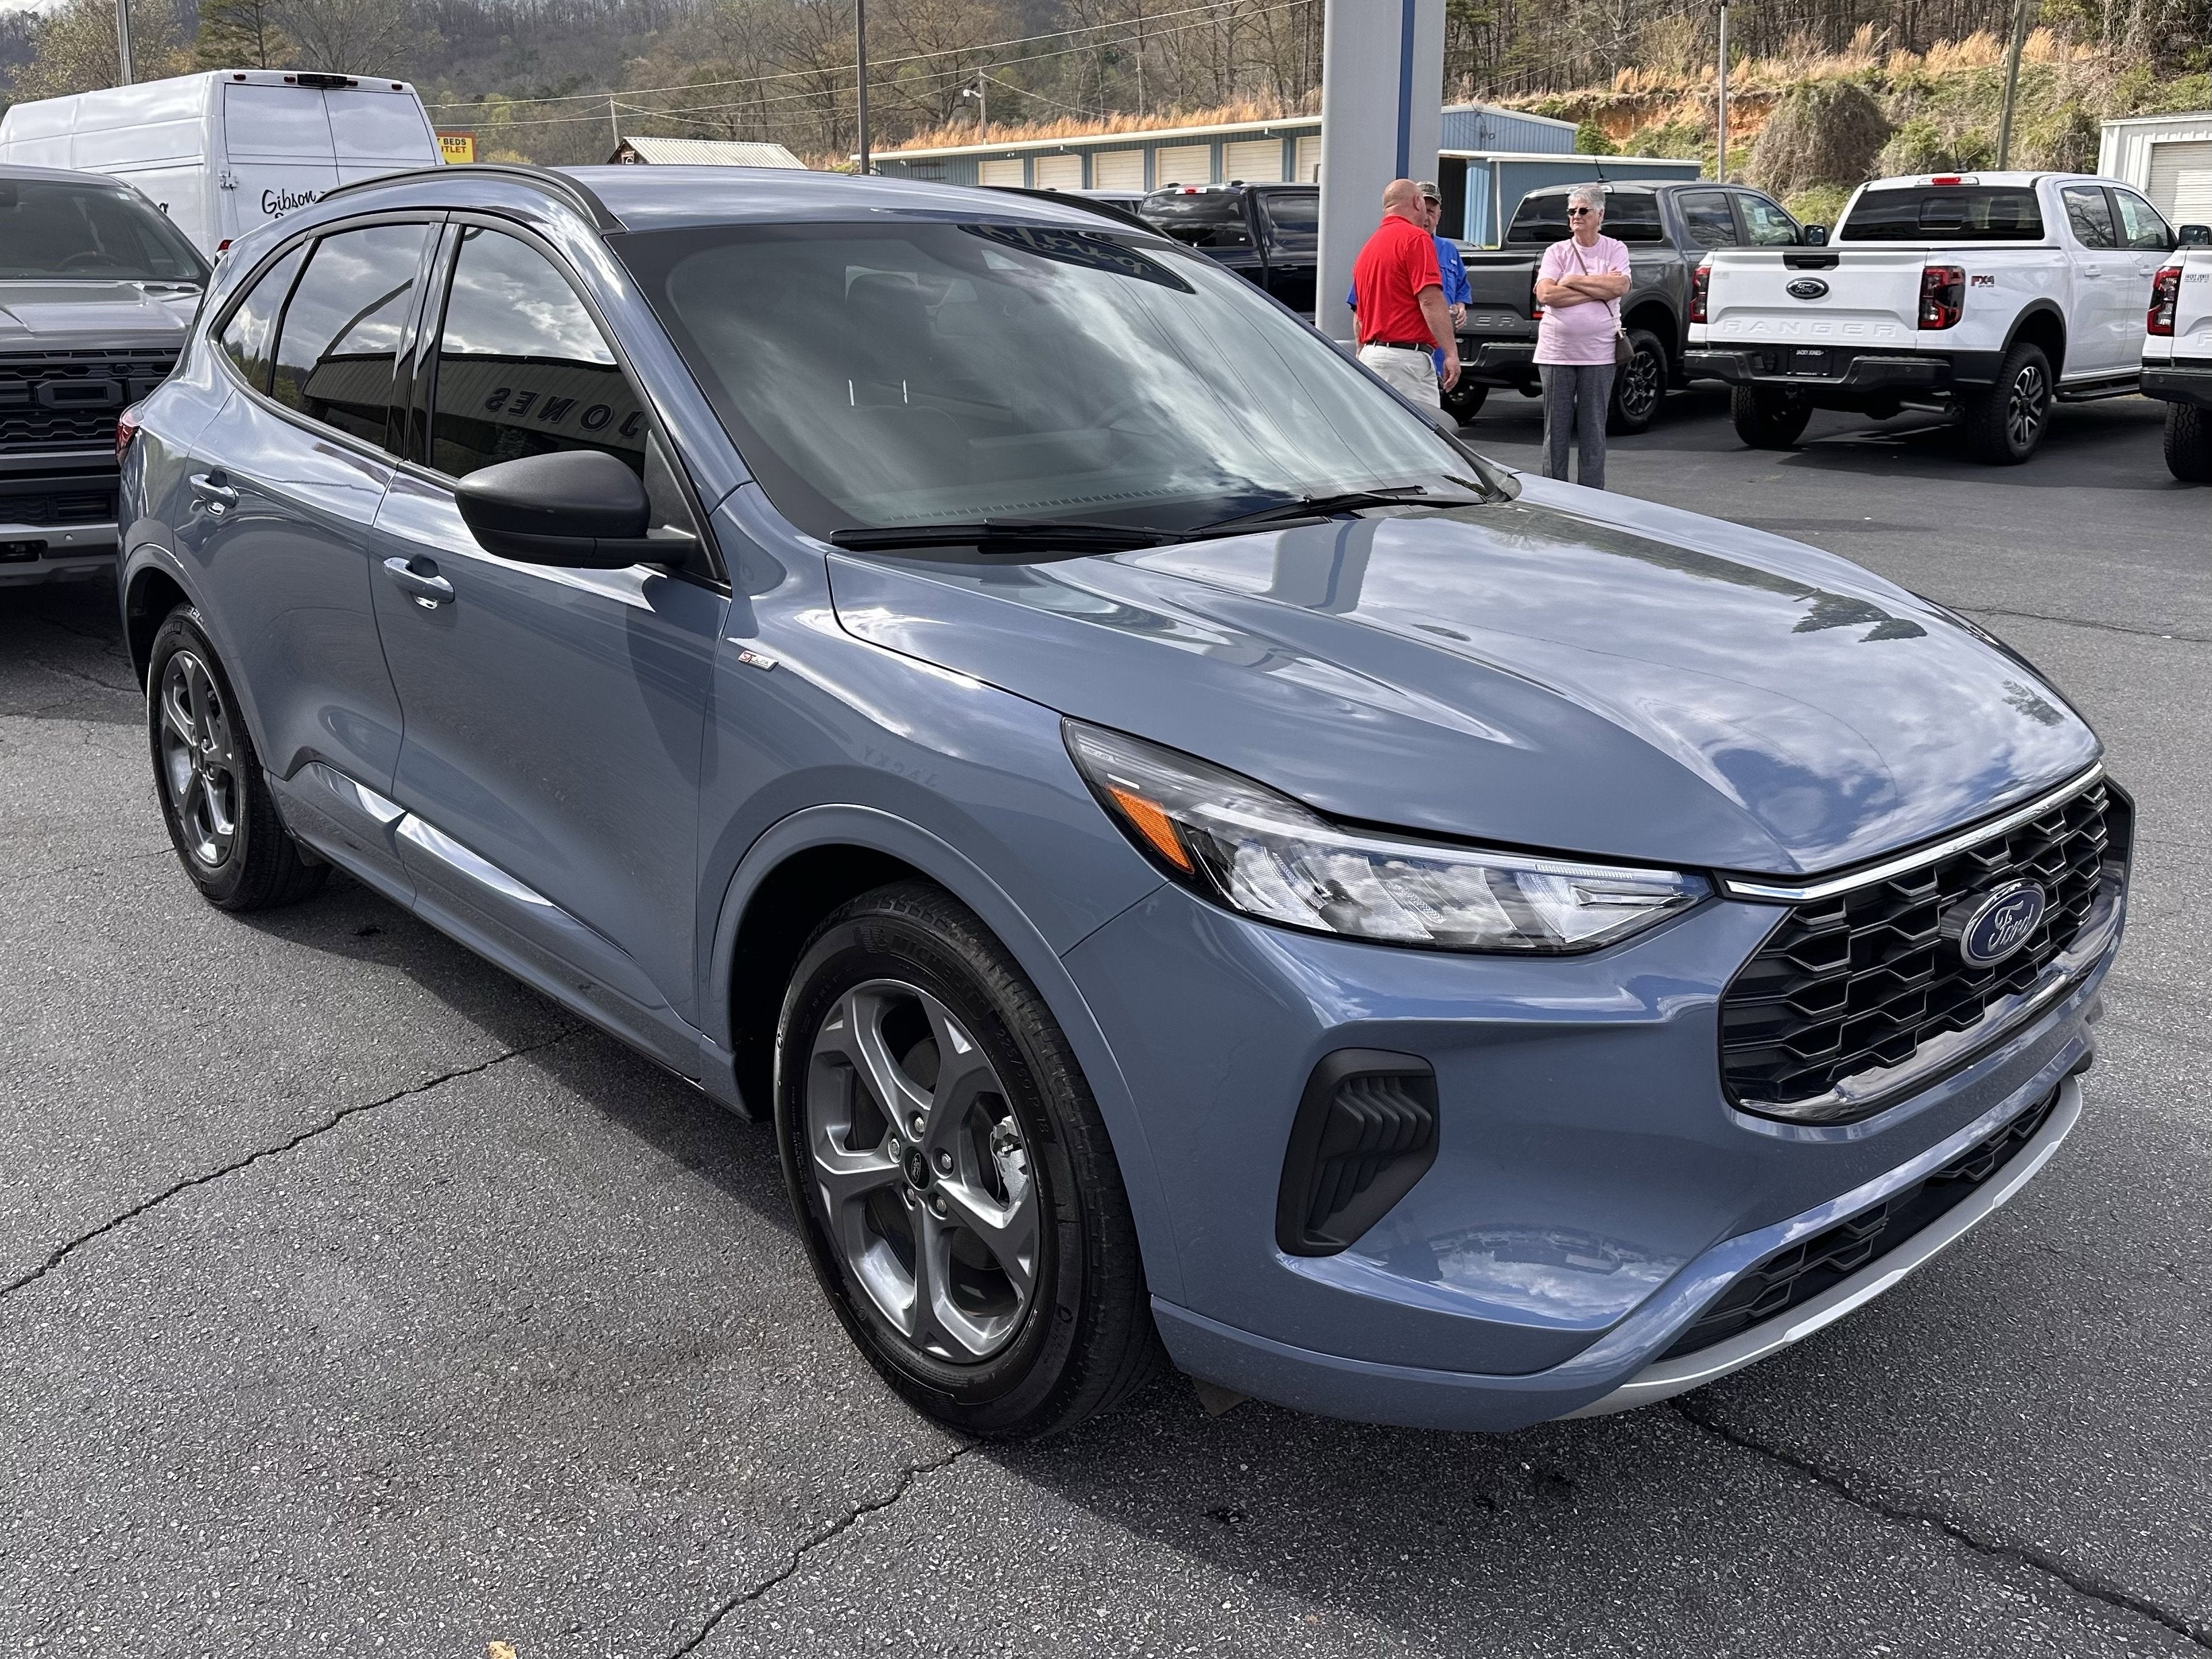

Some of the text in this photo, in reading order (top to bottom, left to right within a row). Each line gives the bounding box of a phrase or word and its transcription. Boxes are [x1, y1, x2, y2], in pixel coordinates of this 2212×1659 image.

[262, 189, 316, 214] Gibson
[1971, 275, 1995, 286] FX4
[1722, 320, 1897, 337] RANGER
[1987, 900, 2034, 952] Ford
